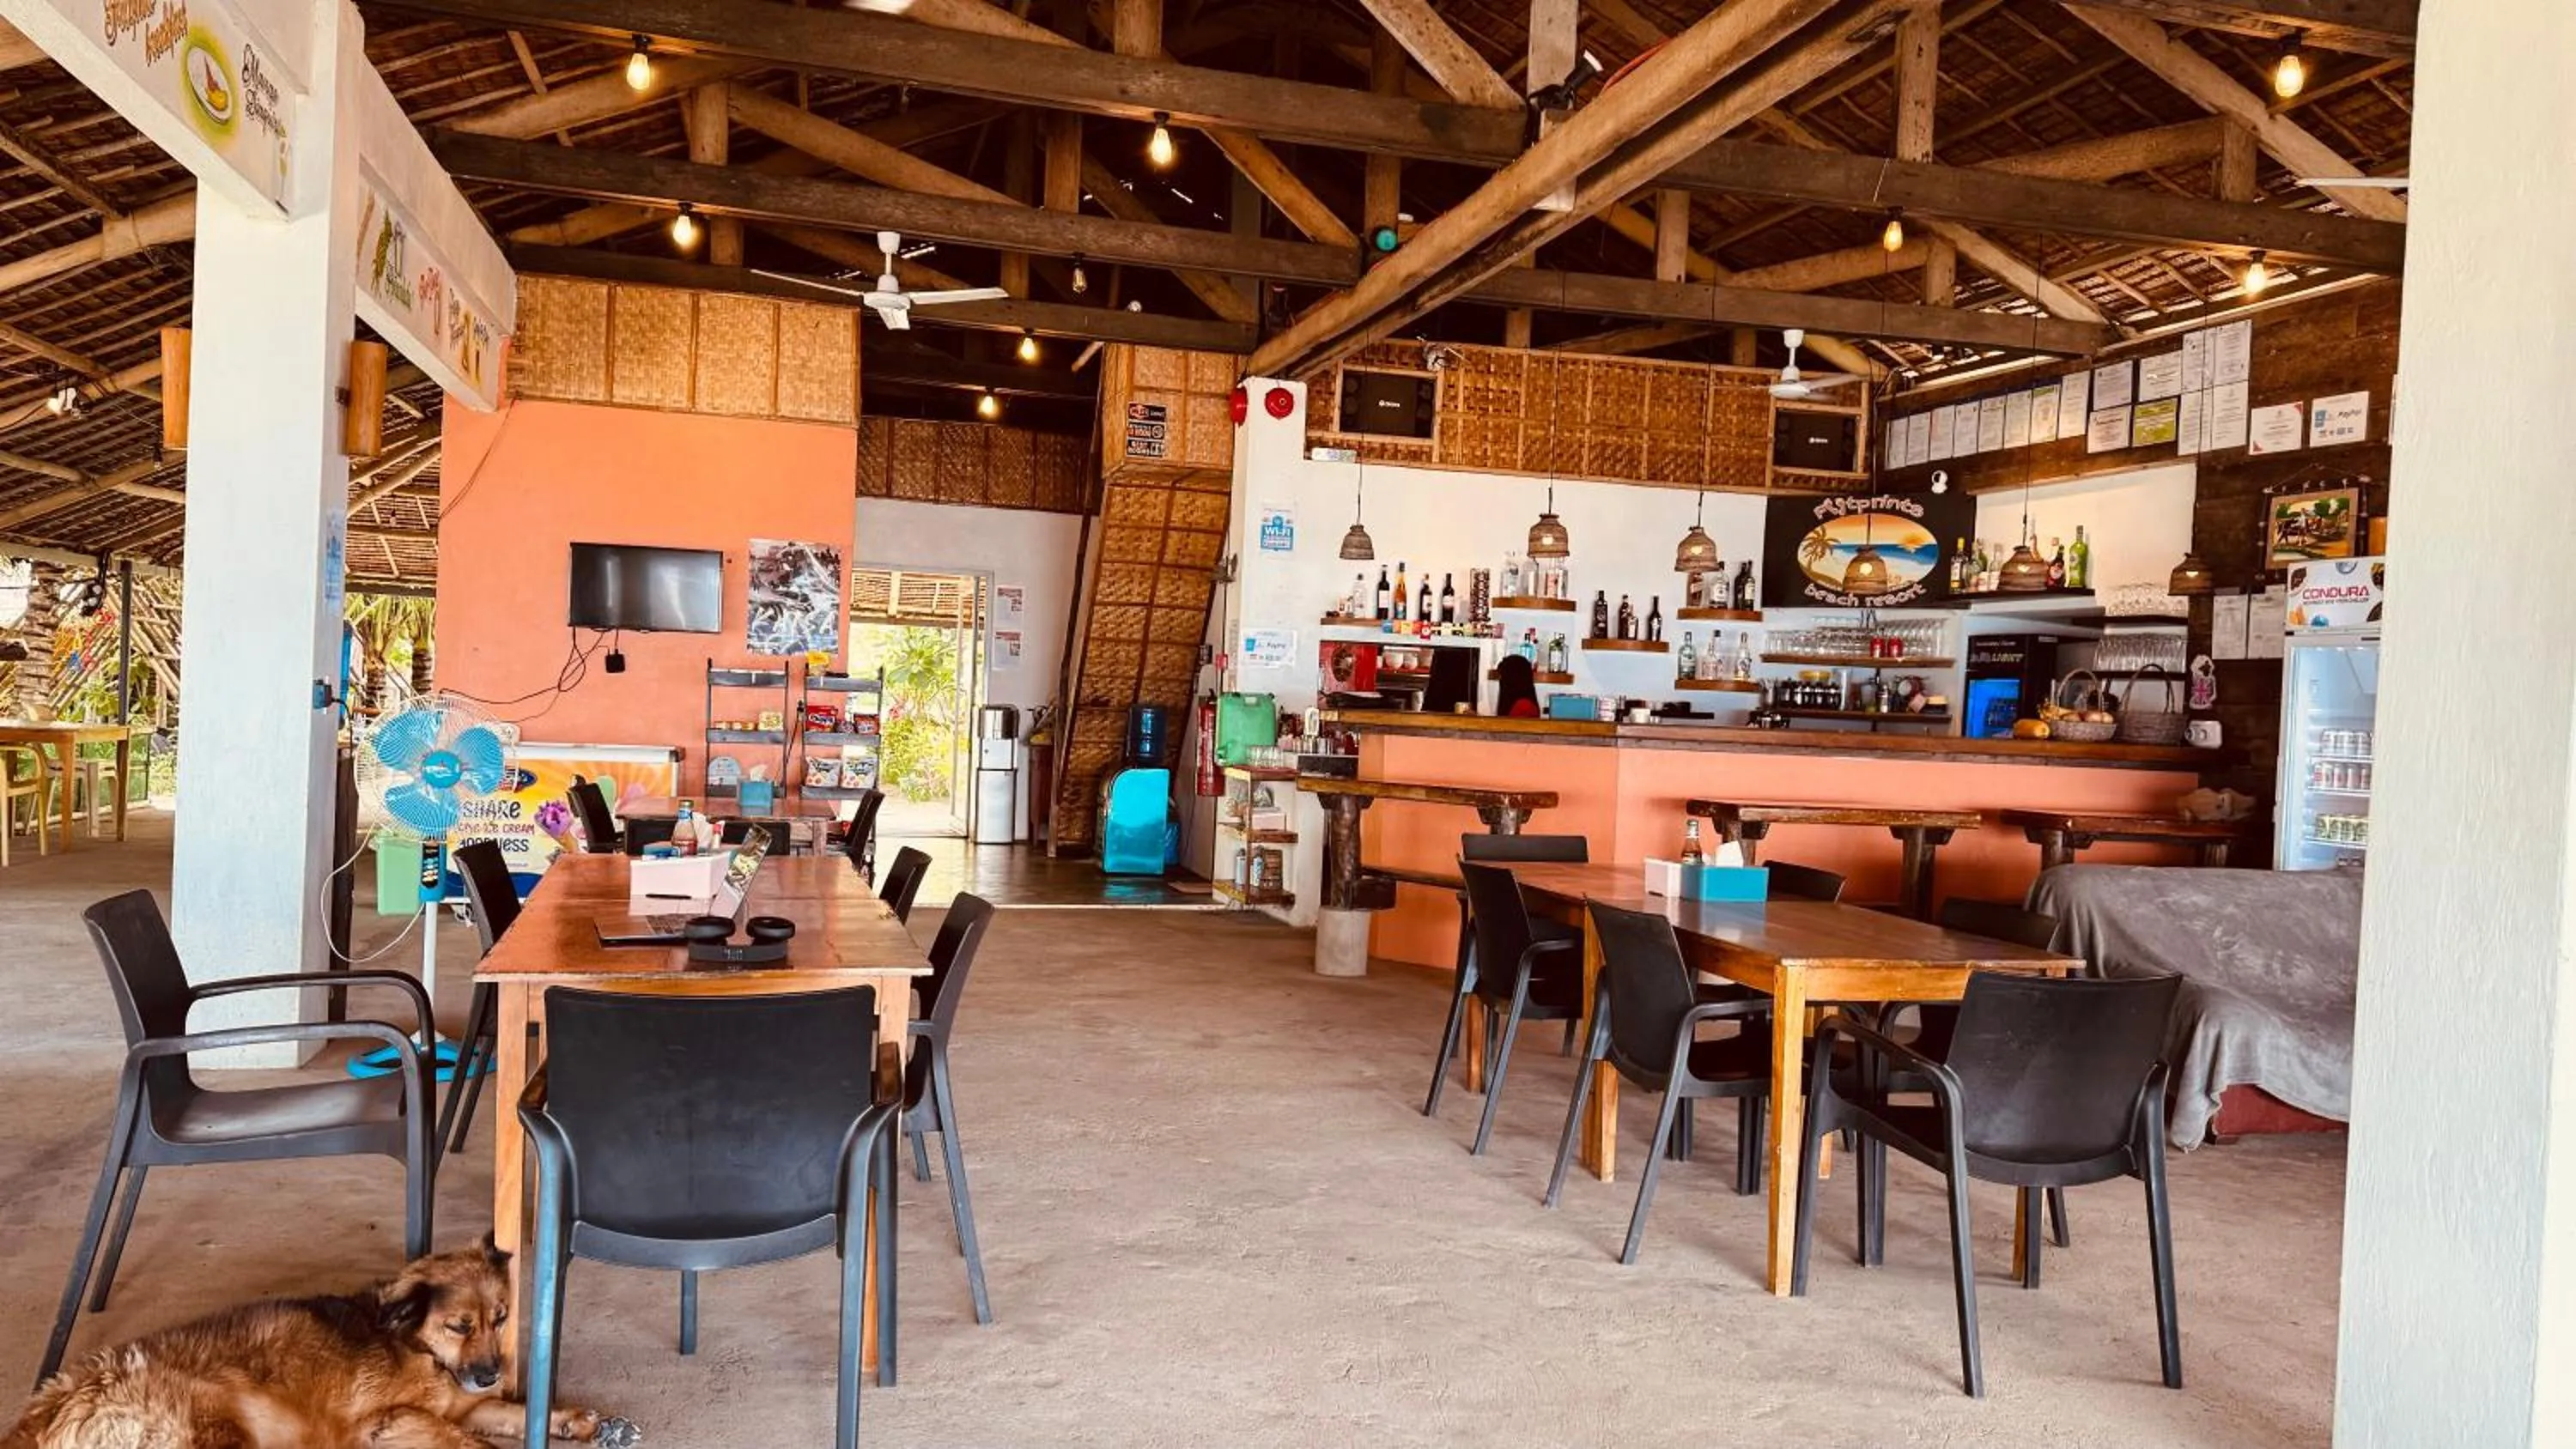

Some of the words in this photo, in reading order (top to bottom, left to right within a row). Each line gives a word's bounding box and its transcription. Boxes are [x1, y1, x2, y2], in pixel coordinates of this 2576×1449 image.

[1804, 583, 1859, 606] beach
[1864, 583, 1928, 606] resort
[2302, 585, 2370, 600] CONDURA
